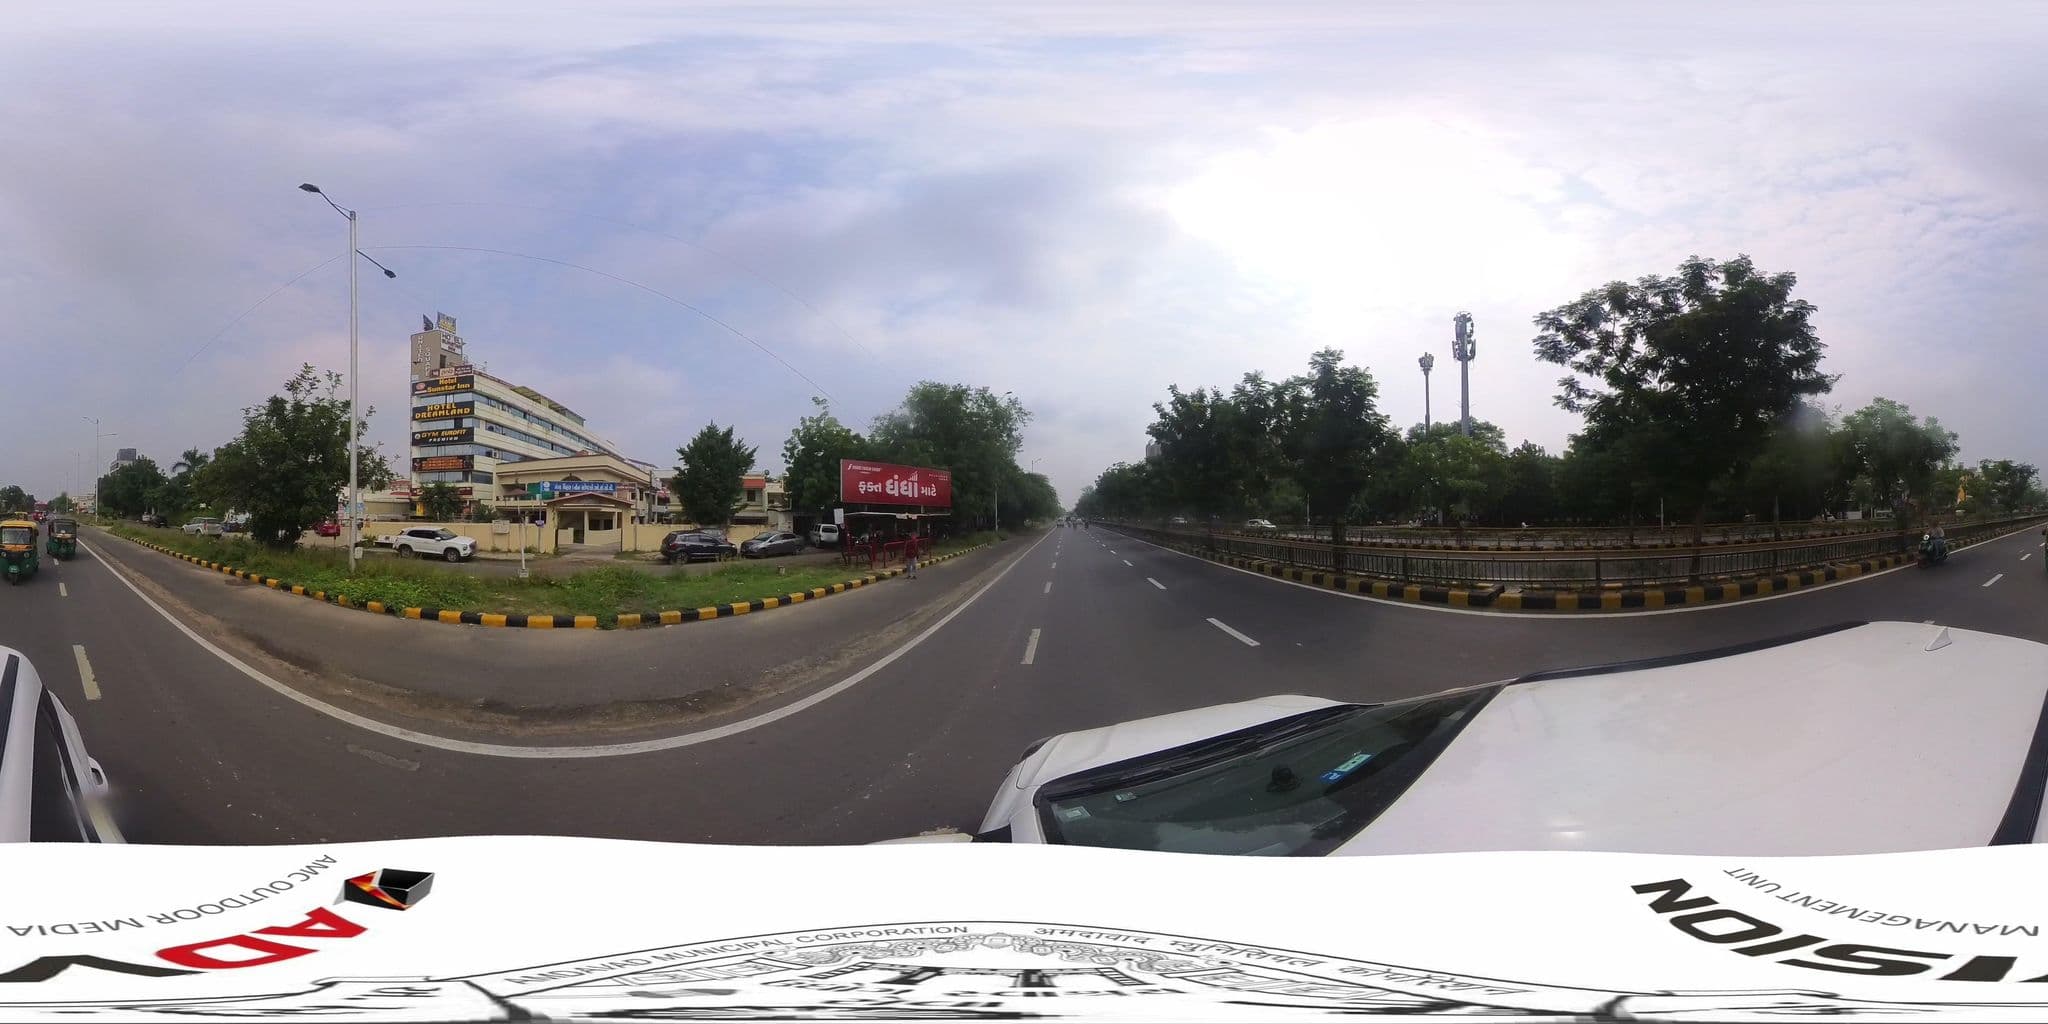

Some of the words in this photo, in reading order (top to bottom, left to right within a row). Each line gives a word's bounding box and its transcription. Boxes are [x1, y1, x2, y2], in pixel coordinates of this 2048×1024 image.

[439, 376, 457, 385] Hotel
[427, 385, 456, 393] Sunstar
[427, 402, 457, 411] HOTEL
[415, 407, 471, 419] DREAMLAND
[920, 483, 937, 497] માટે
